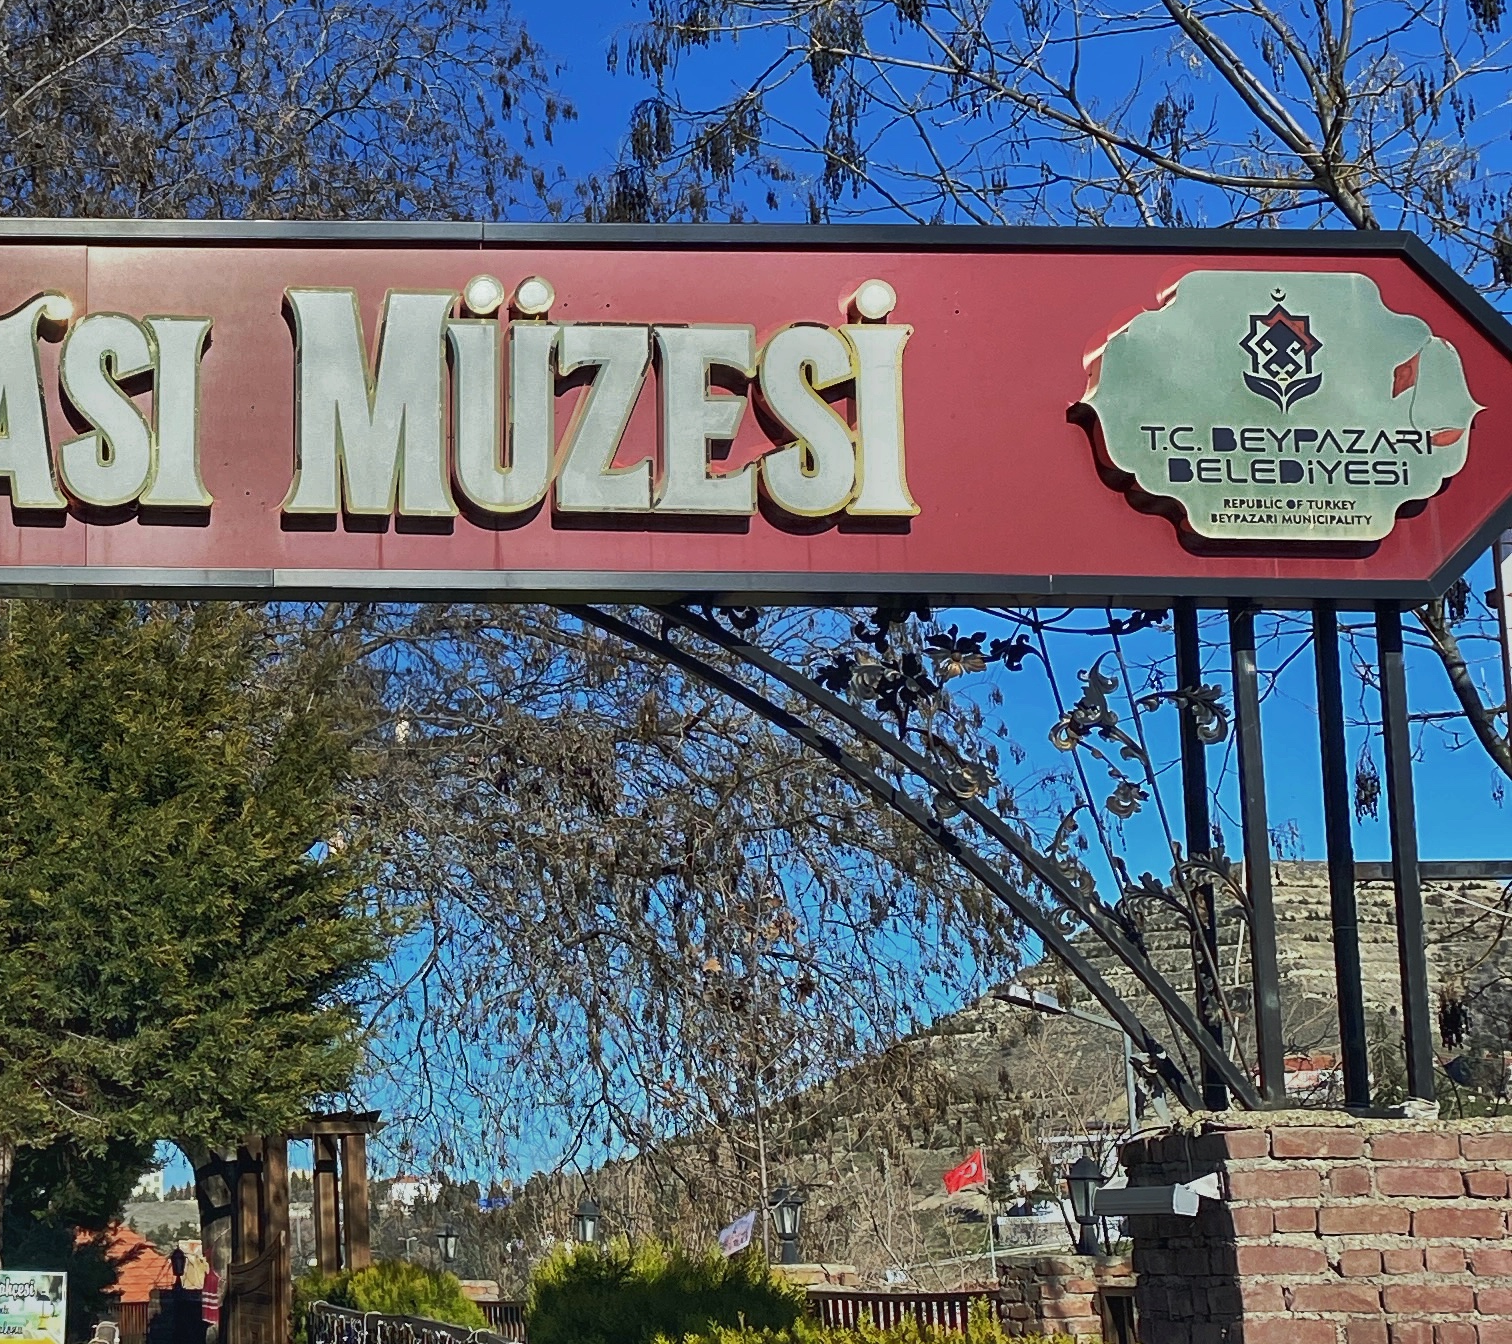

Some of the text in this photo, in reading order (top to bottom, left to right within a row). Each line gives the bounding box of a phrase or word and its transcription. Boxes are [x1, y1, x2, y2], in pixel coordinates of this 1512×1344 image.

[285, 273, 921, 517] MÜZESİ
[1140, 425, 1433, 455] T.C. BEYPAZARI
[1286, 499, 1303, 511] OF
[1306, 499, 1357, 512] TURKEY
[1210, 513, 1373, 526] BEYPAZARI MUNICIPALITY
